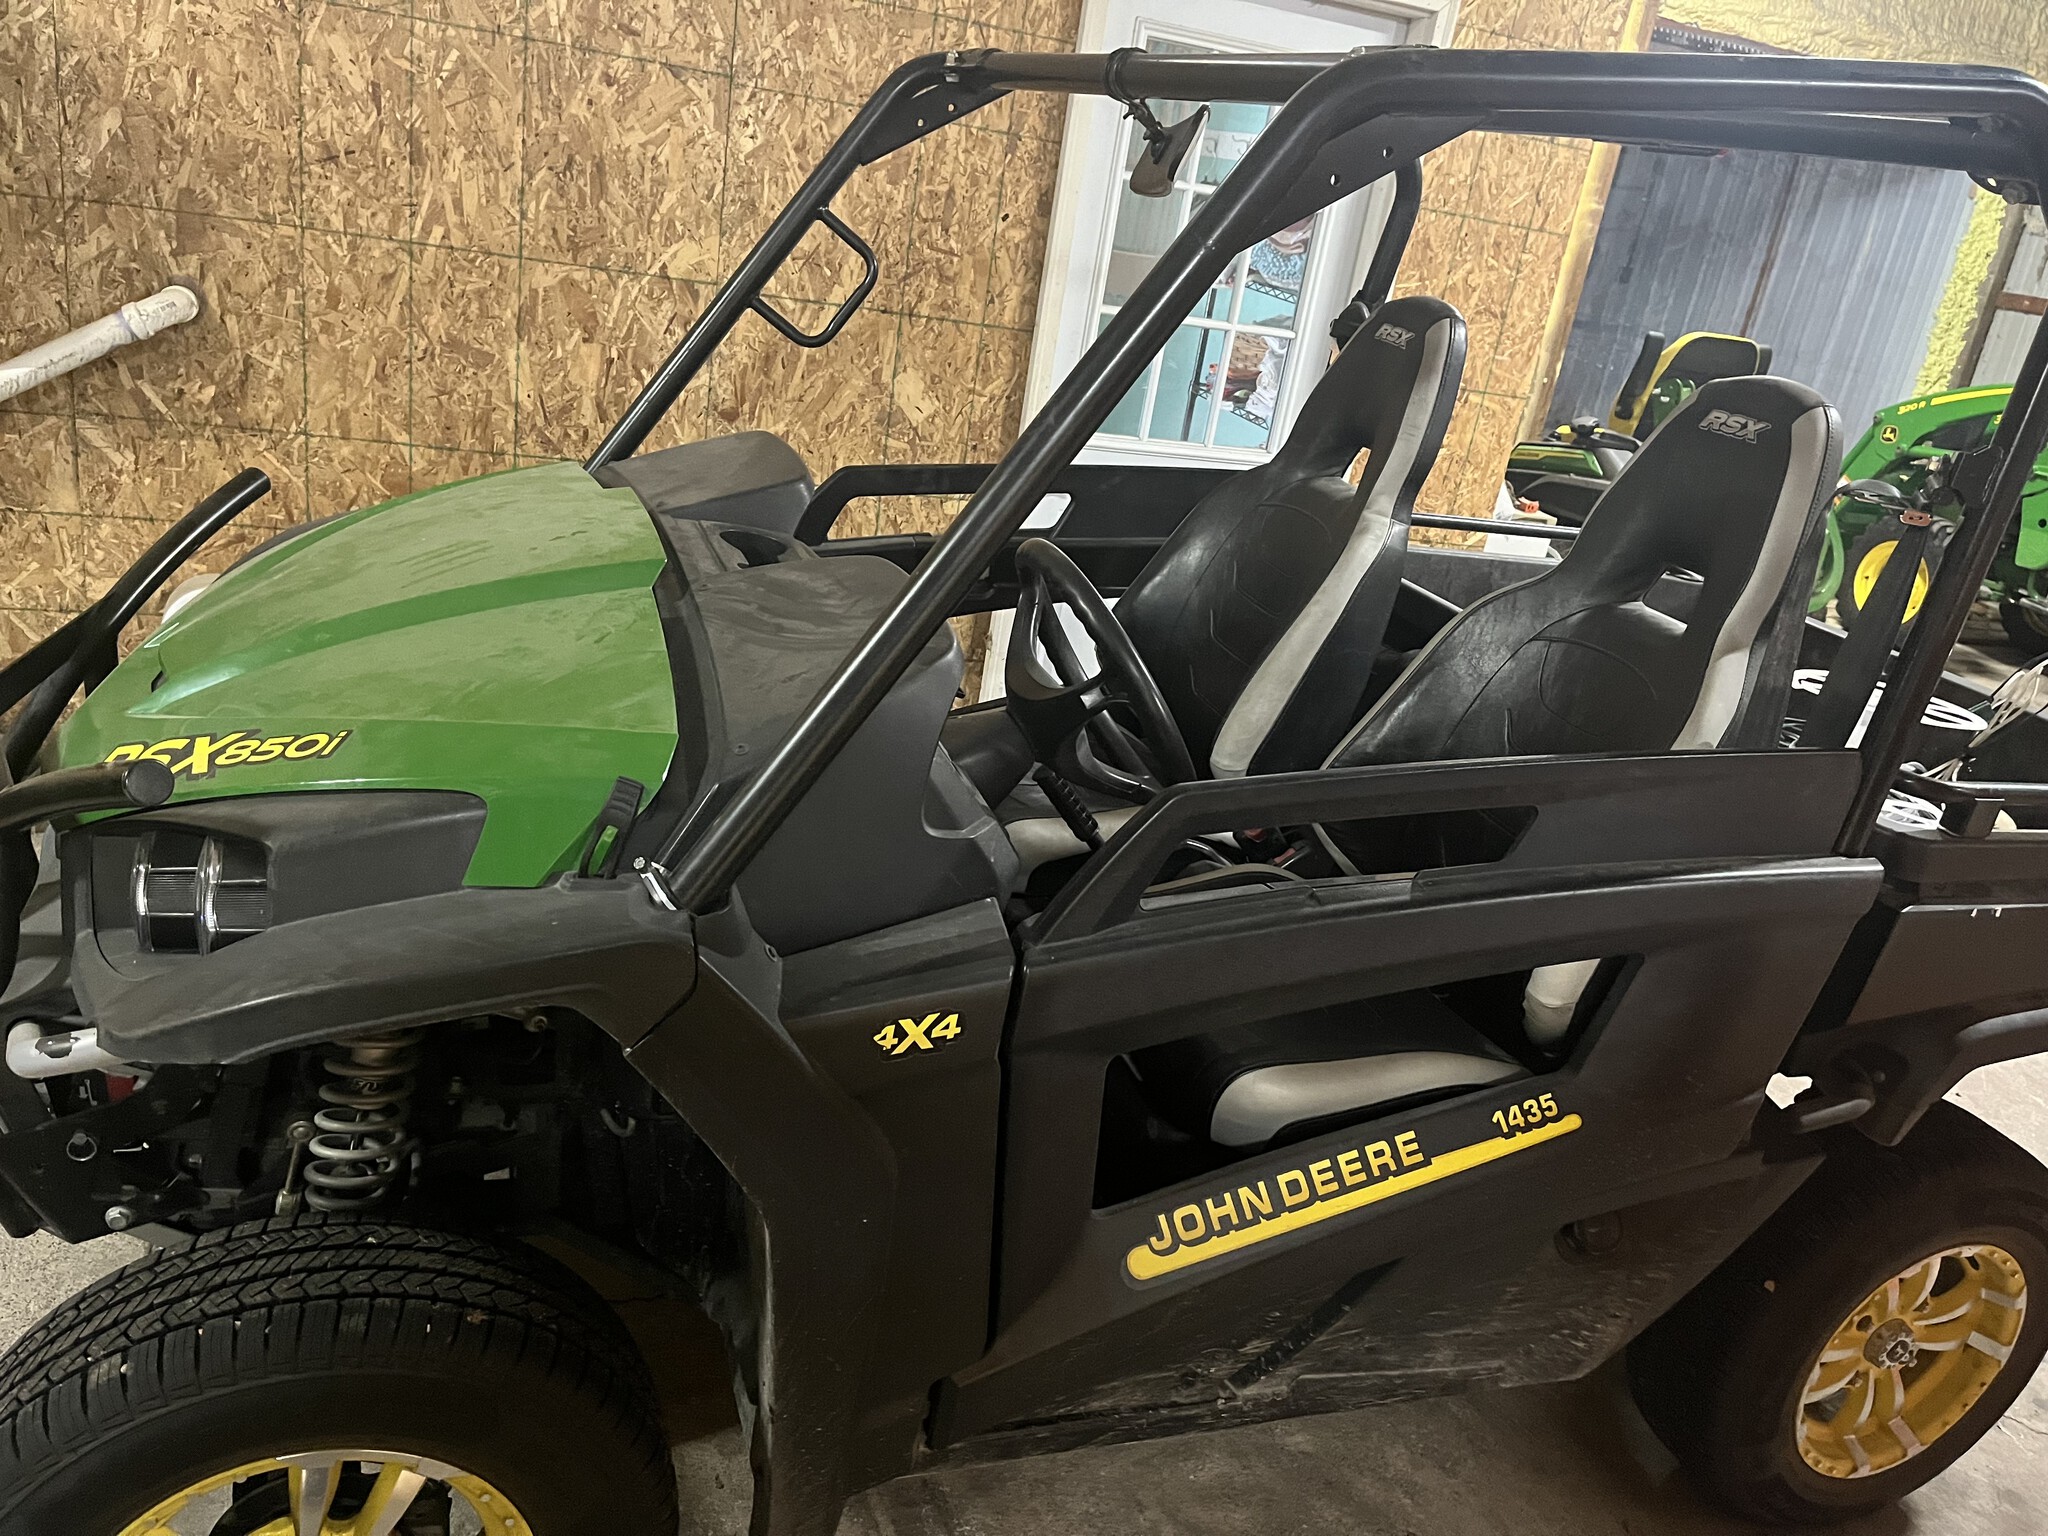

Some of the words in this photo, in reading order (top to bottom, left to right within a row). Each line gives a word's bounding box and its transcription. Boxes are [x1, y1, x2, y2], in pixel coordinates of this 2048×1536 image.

[1374, 323, 1416, 350] RSX
[1699, 409, 1772, 444] RSX
[872, 1012, 962, 1056] 4X4
[1149, 1181, 1274, 1251] JOHN
[1276, 1130, 1425, 1208] DEERE
[1491, 1092, 1559, 1134] 1435
